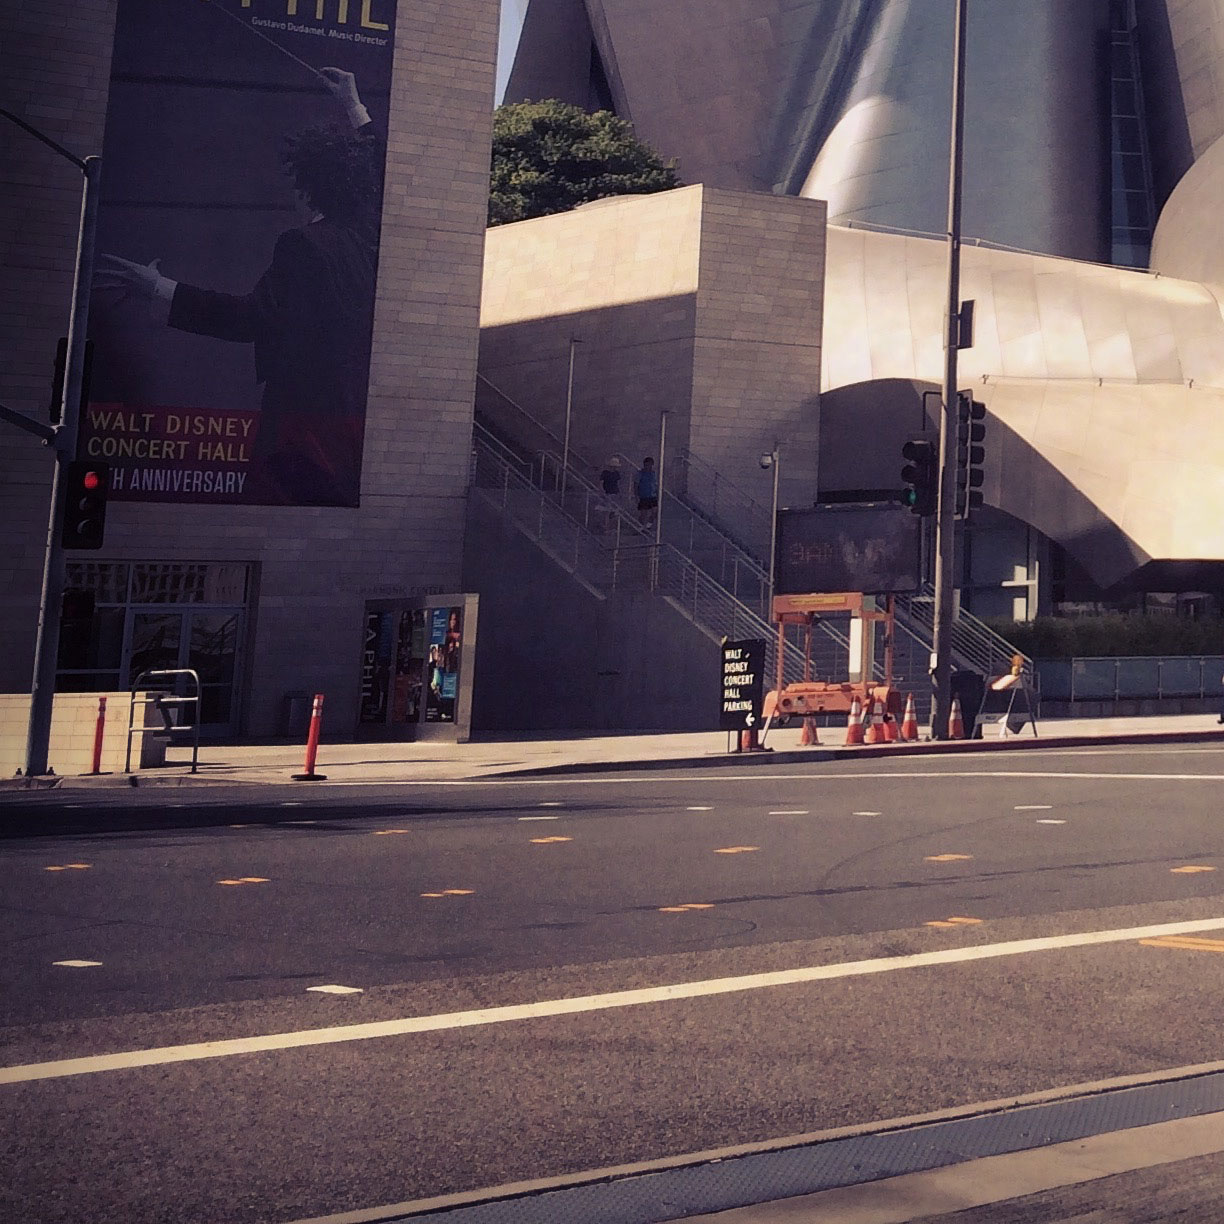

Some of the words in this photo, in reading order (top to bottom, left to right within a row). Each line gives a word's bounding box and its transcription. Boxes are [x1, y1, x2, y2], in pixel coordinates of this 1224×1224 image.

[251, 16, 287, 30] Gustavo
[328, 29, 354, 41] Music
[354, 33, 389, 46] Director
[90, 410, 155, 432] WALT
[165, 414, 253, 437] DISNEY
[87, 436, 189, 460] CONCERT
[197, 441, 250, 462] HALL
[129, 467, 247, 494] ANNIVERSARY
[366, 614, 378, 642] LA
[724, 648, 743, 660] WALT
[724, 661, 749, 673] DISNEY
[723, 674, 755, 687] CONCERT
[724, 688, 741, 699] HALL
[723, 700, 753, 712] PARKING
